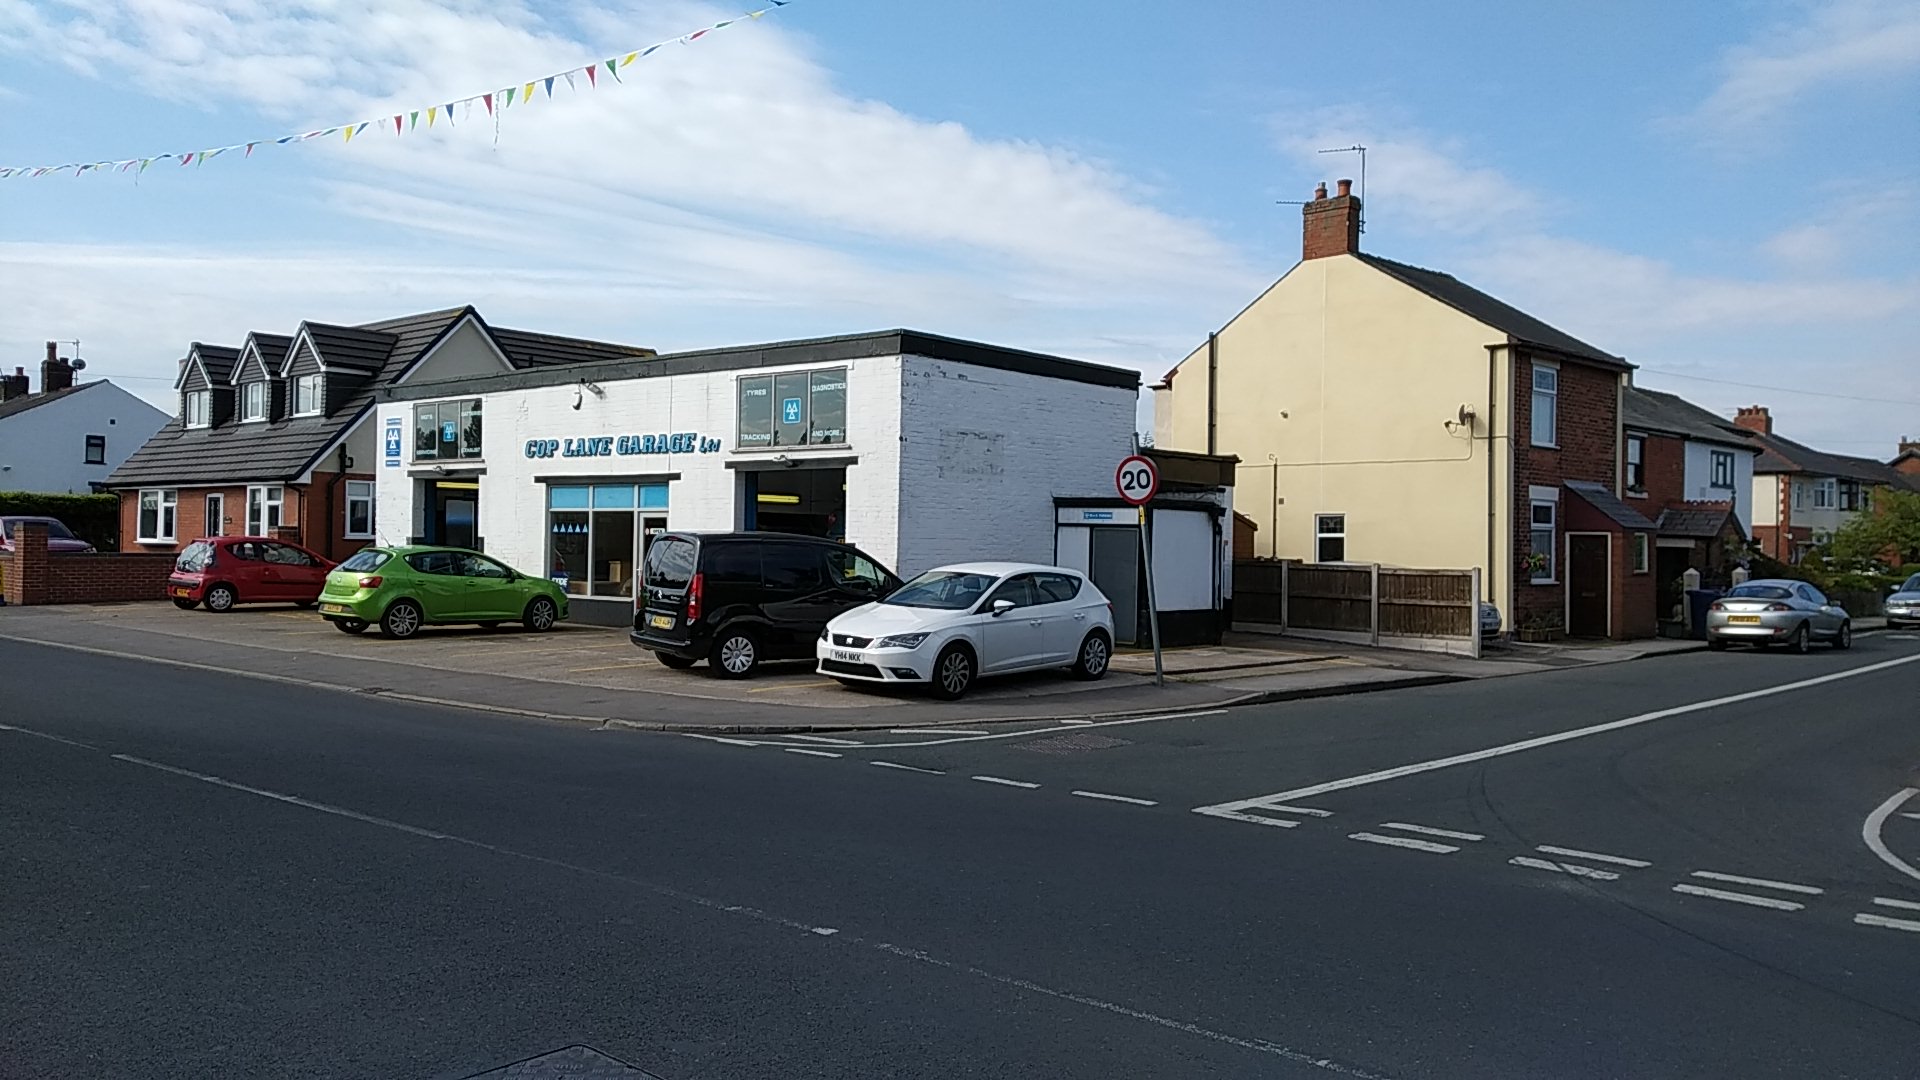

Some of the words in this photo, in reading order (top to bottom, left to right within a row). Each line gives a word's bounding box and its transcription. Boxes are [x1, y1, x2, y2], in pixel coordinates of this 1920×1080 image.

[746, 388, 767, 397] TYRES
[811, 382, 847, 392] DIAGNOSTICS
[740, 433, 771, 441] TRACKING
[525, 439, 559, 458] COP
[562, 437, 613, 457] LANE
[616, 433, 697, 456] GARAGE
[1122, 468, 1151, 490] 20
[834, 650, 847, 660] YH14
[848, 652, 861, 662] NKK
